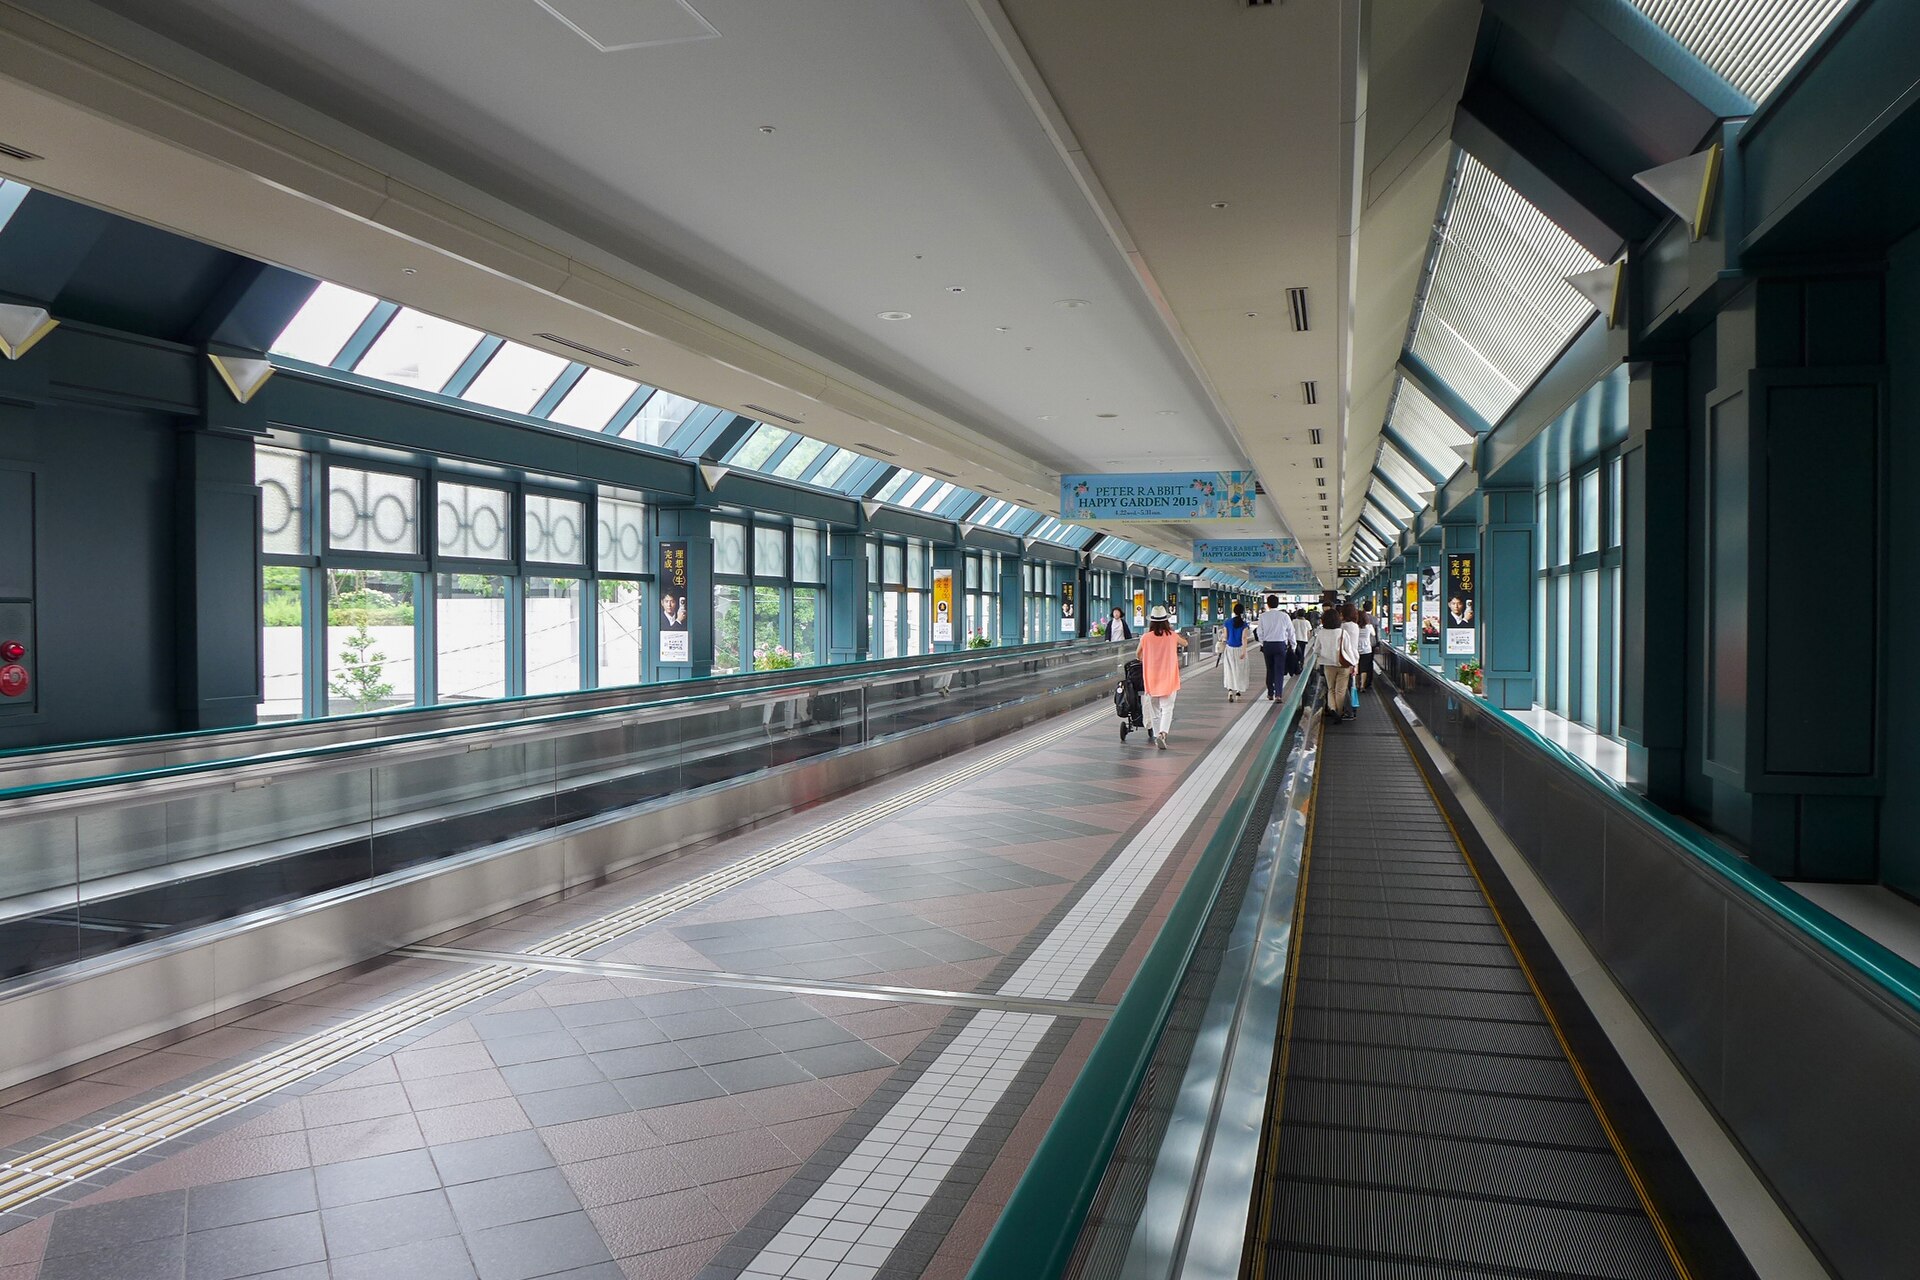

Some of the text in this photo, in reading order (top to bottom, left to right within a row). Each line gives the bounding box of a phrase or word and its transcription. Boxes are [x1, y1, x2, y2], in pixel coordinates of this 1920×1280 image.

[1096, 485, 1184, 496] PETER RABBIT
[1079, 496, 1198, 508] HAPPY GARDEN 2015
